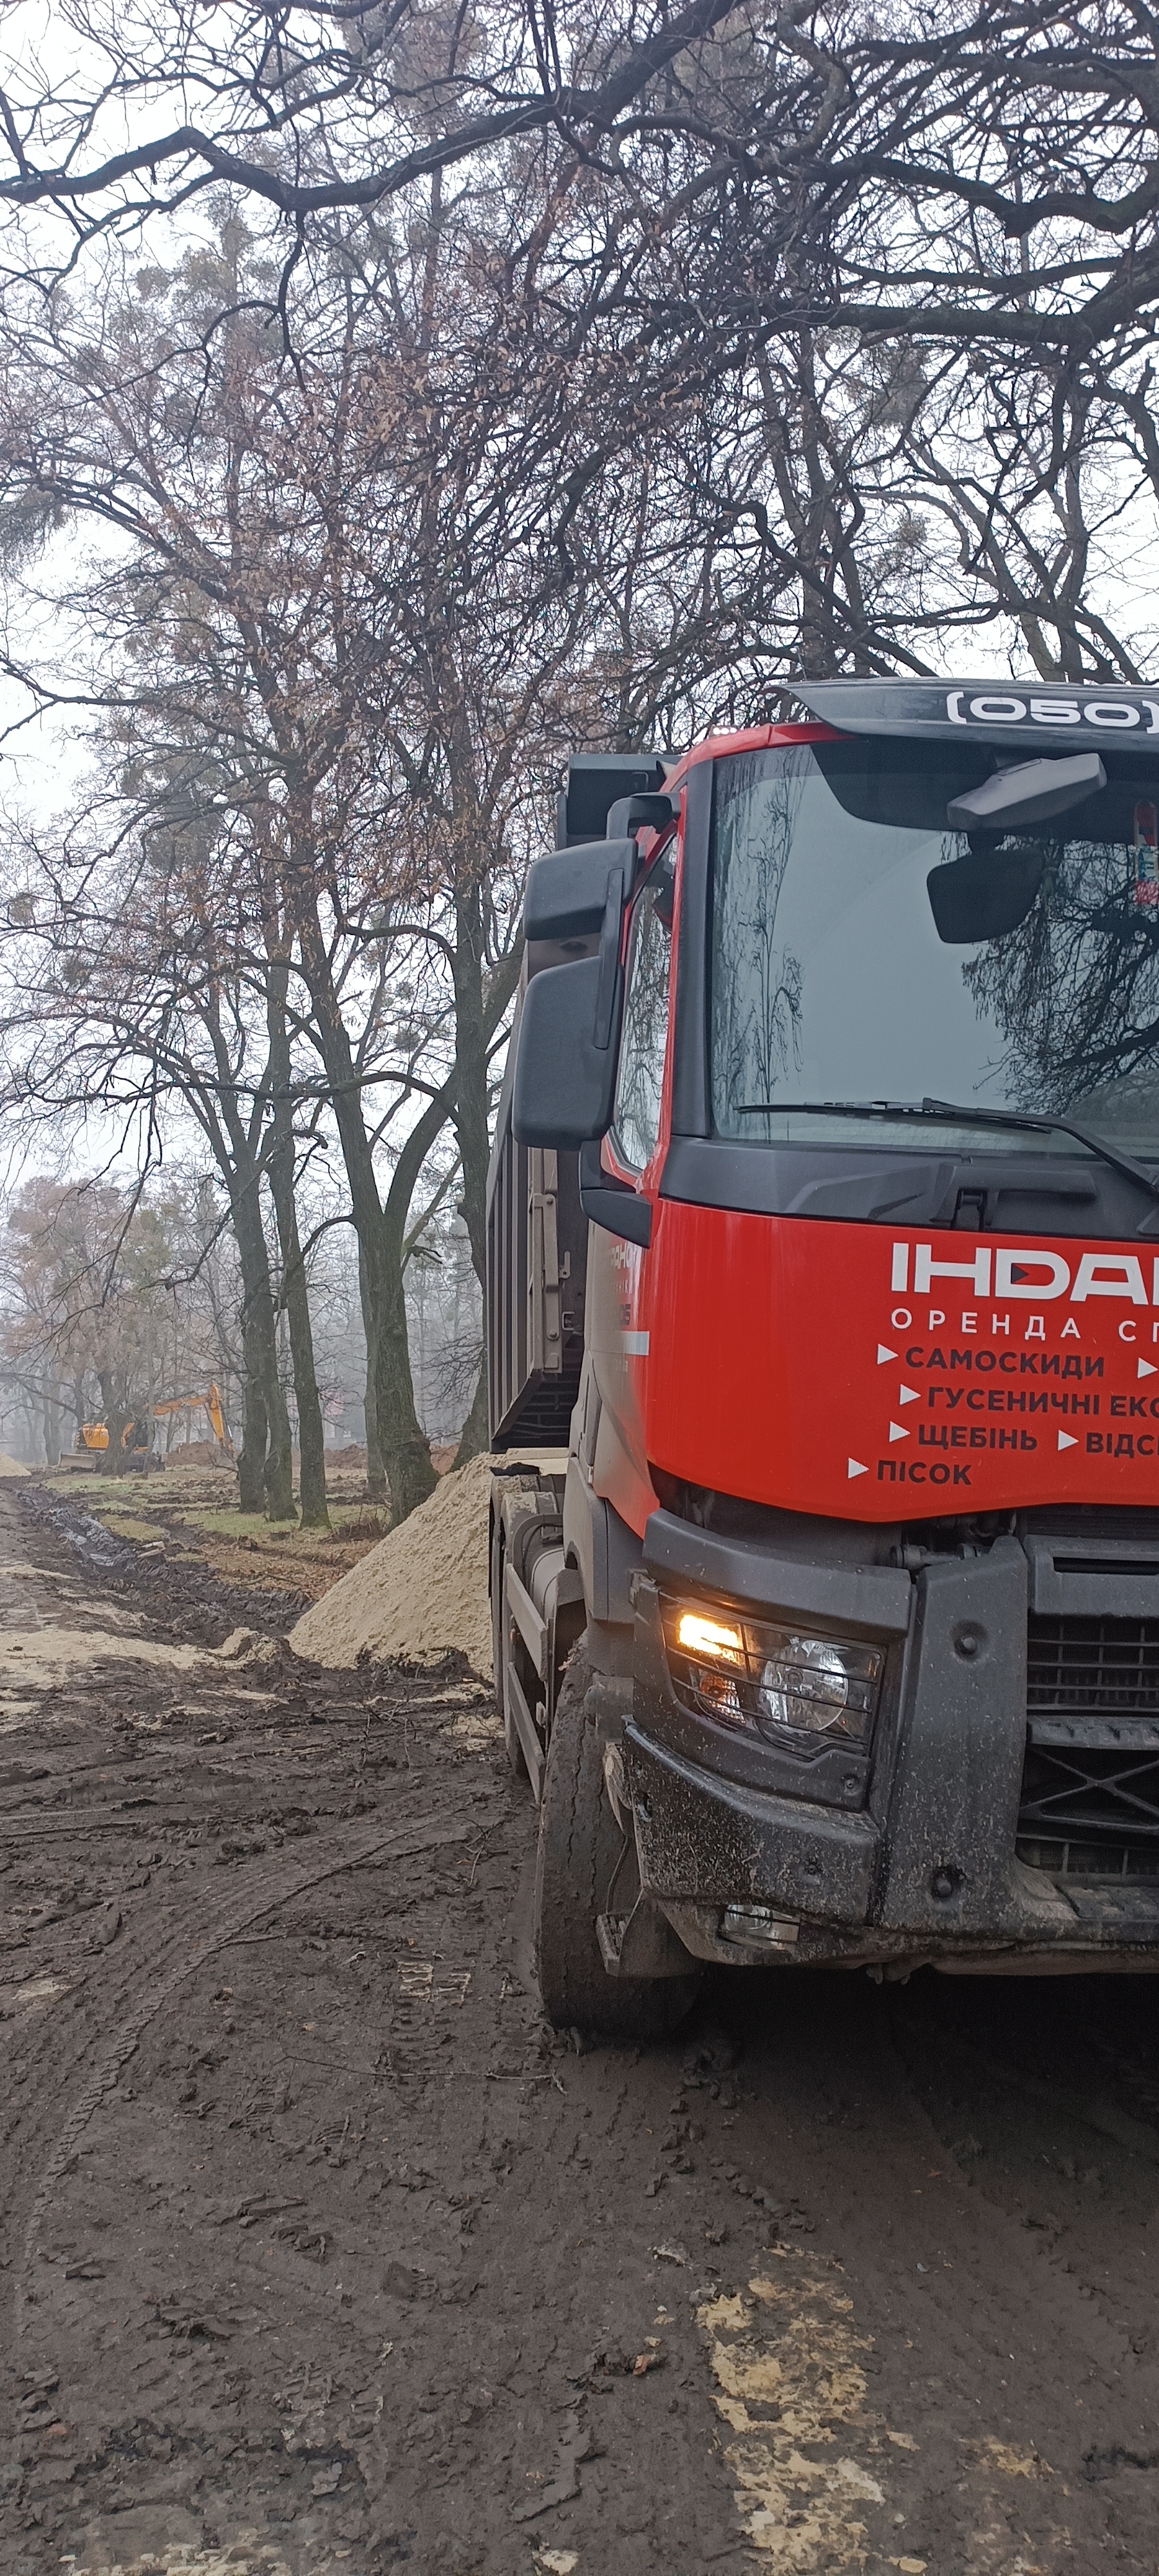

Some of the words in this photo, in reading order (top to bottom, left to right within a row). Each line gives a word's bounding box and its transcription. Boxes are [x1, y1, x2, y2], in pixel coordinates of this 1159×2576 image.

[946, 690, 1159, 734] (050)
[890, 1242, 1159, 1306] ІНДА
[890, 1307, 1081, 1341] ОРЕНДА
[905, 1347, 1105, 1380] САМОСКИДИ
[927, 1387, 1100, 1416] ГУСЕНИЧНІ
[918, 1424, 1038, 1451] ЩЕБІНЬ
[1086, 1432, 1159, 1459] ВІДС
[877, 1459, 973, 1486] ПІСОК
